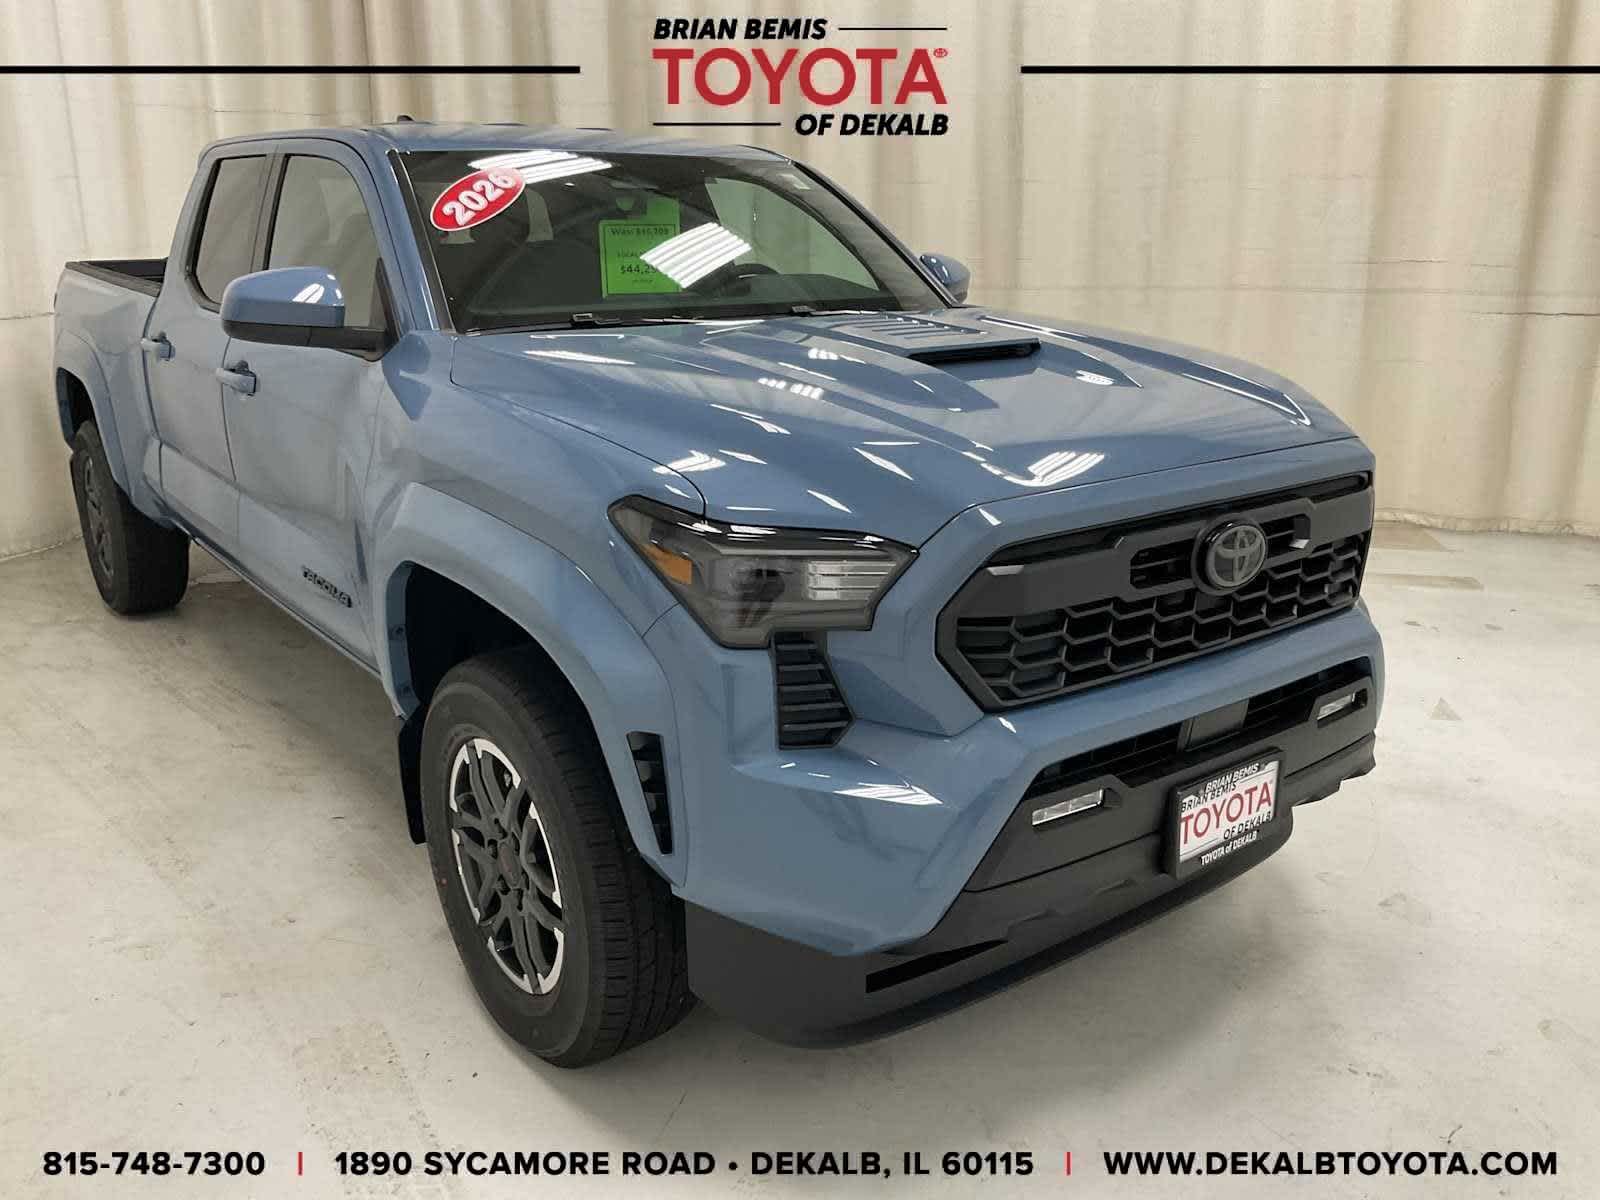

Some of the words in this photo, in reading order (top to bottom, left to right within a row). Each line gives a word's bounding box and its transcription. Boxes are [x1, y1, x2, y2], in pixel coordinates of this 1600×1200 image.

[442, 172, 517, 226] 2026
[1205, 773, 1233, 793] BRIAN
[1233, 762, 1260, 781] BEMIS
[1180, 781, 1272, 845] TOYOTA
[1181, 792, 1209, 813] BRIAN
[1210, 782, 1237, 801] BEMIS
[1223, 825, 1236, 840] OF
[1237, 811, 1272, 833] DEKALB
[1201, 847, 1225, 866] TOYOTA
[1232, 831, 1258, 851] DEKALB
